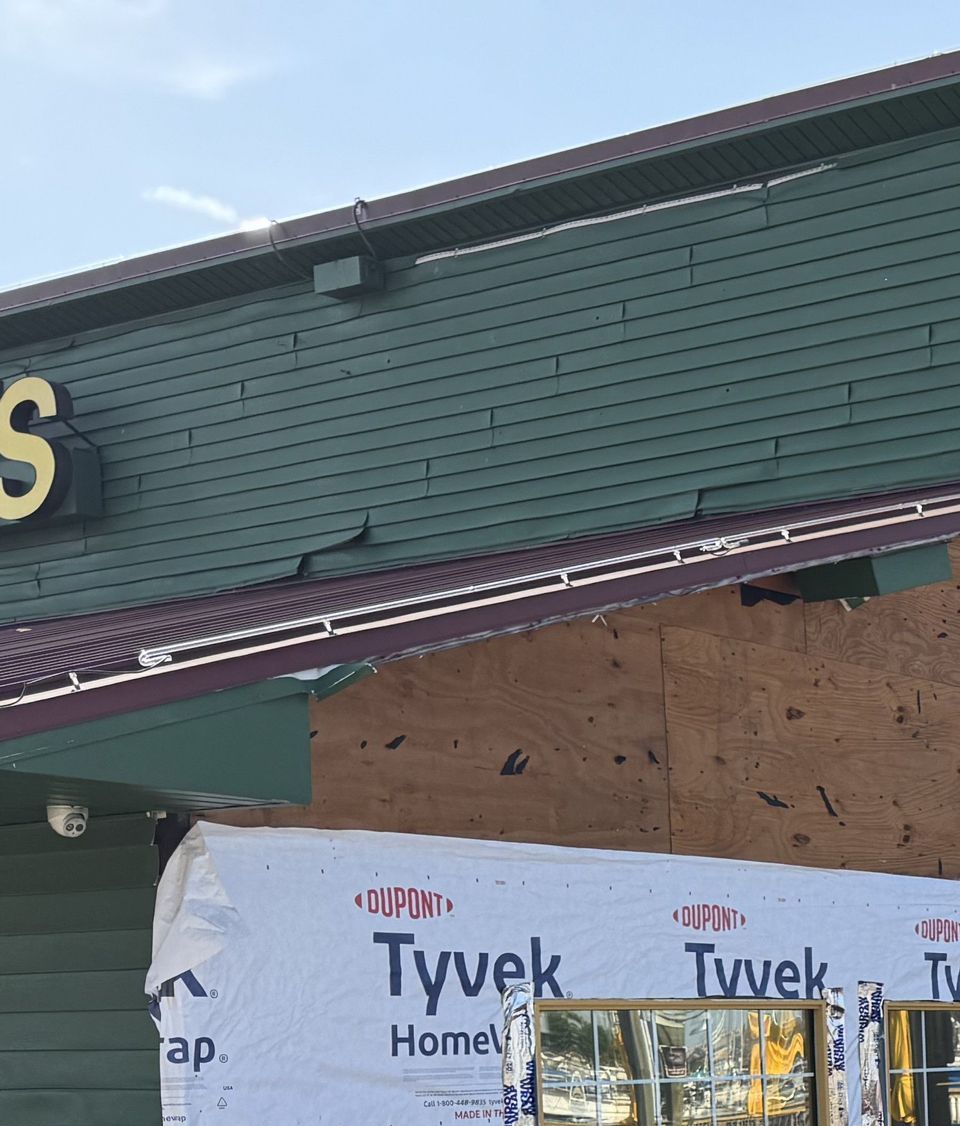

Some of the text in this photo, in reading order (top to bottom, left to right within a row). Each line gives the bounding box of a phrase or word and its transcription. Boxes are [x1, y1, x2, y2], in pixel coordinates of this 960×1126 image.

[366, 886, 444, 919] DUPONT
[681, 903, 739, 932] DUPONT
[373, 932, 565, 1015] Tyvek
[685, 942, 828, 1000] Tyvek
[391, 1024, 503, 1057] Home
[454, 1110, 481, 1119] MADE
[482, 1109, 492, 1118] IN
